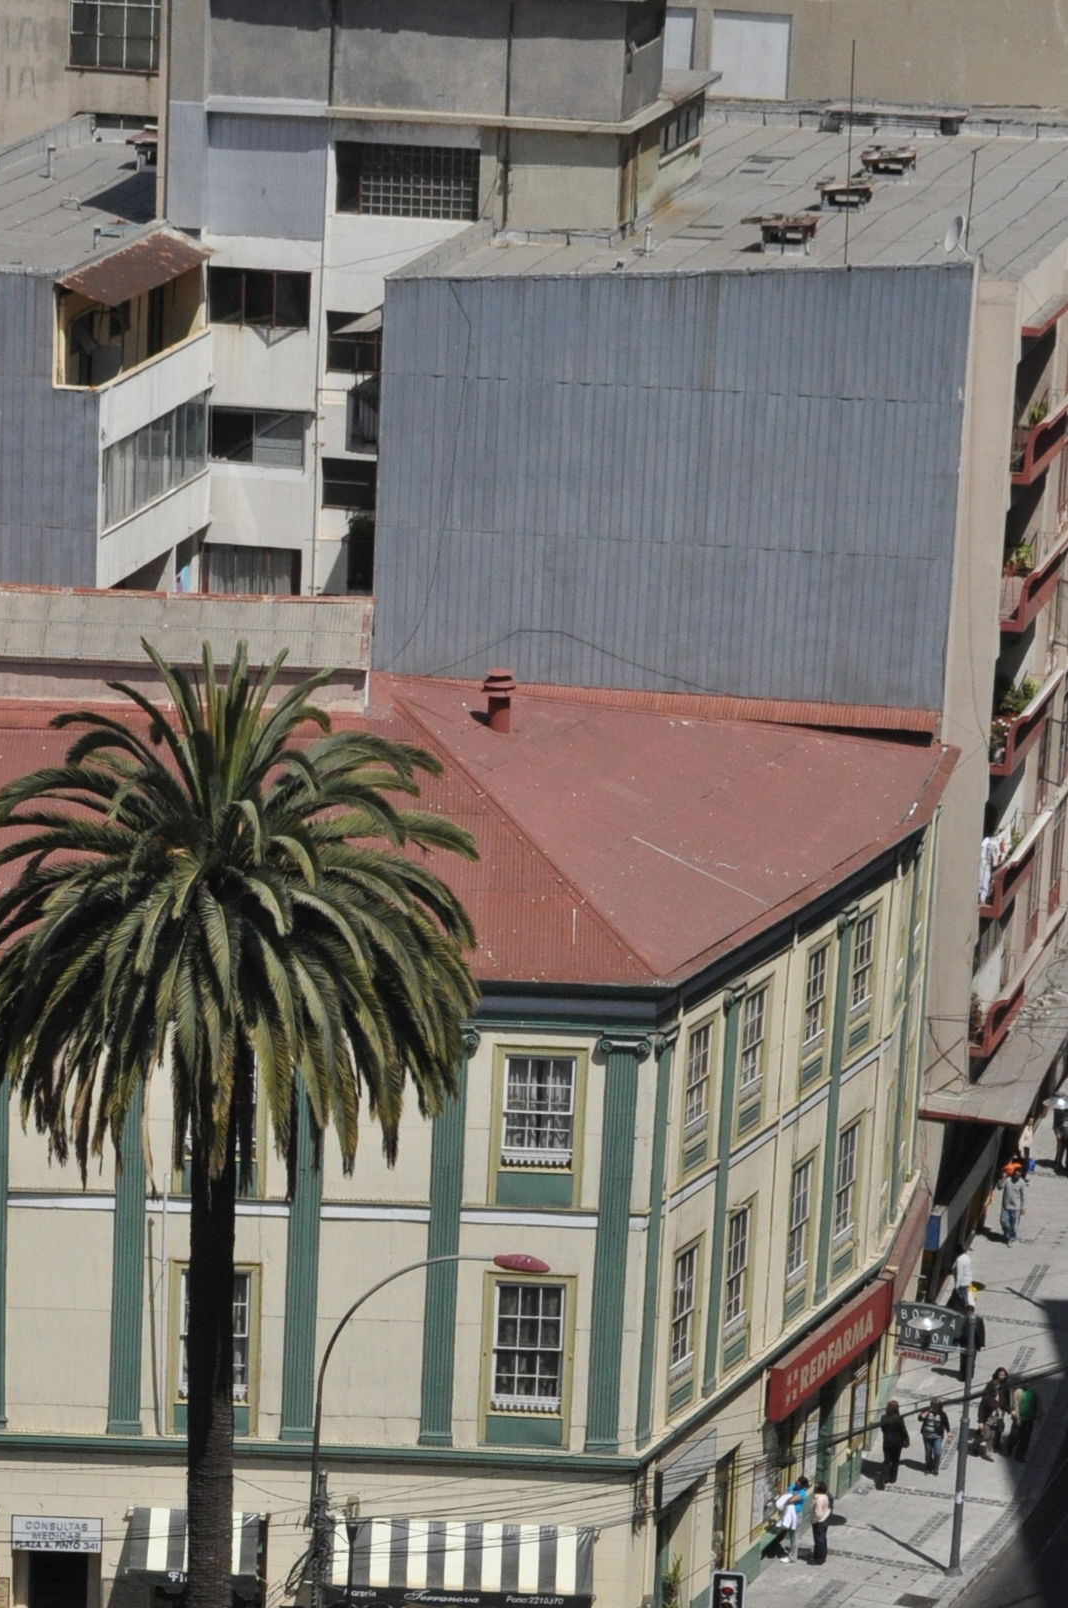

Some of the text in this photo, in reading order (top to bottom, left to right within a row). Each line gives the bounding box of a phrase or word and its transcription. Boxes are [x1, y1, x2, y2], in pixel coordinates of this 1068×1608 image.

[904, 1327, 950, 1345] UNON
[799, 1309, 874, 1393] REDFARMA
[25, 1521, 88, 1532] CONSULTAS
[14, 1540, 42, 1549] PLAZA
[55, 1541, 81, 1550] PINTO
[83, 1543, 99, 1551] 341
[404, 1590, 481, 1604] Terranova
